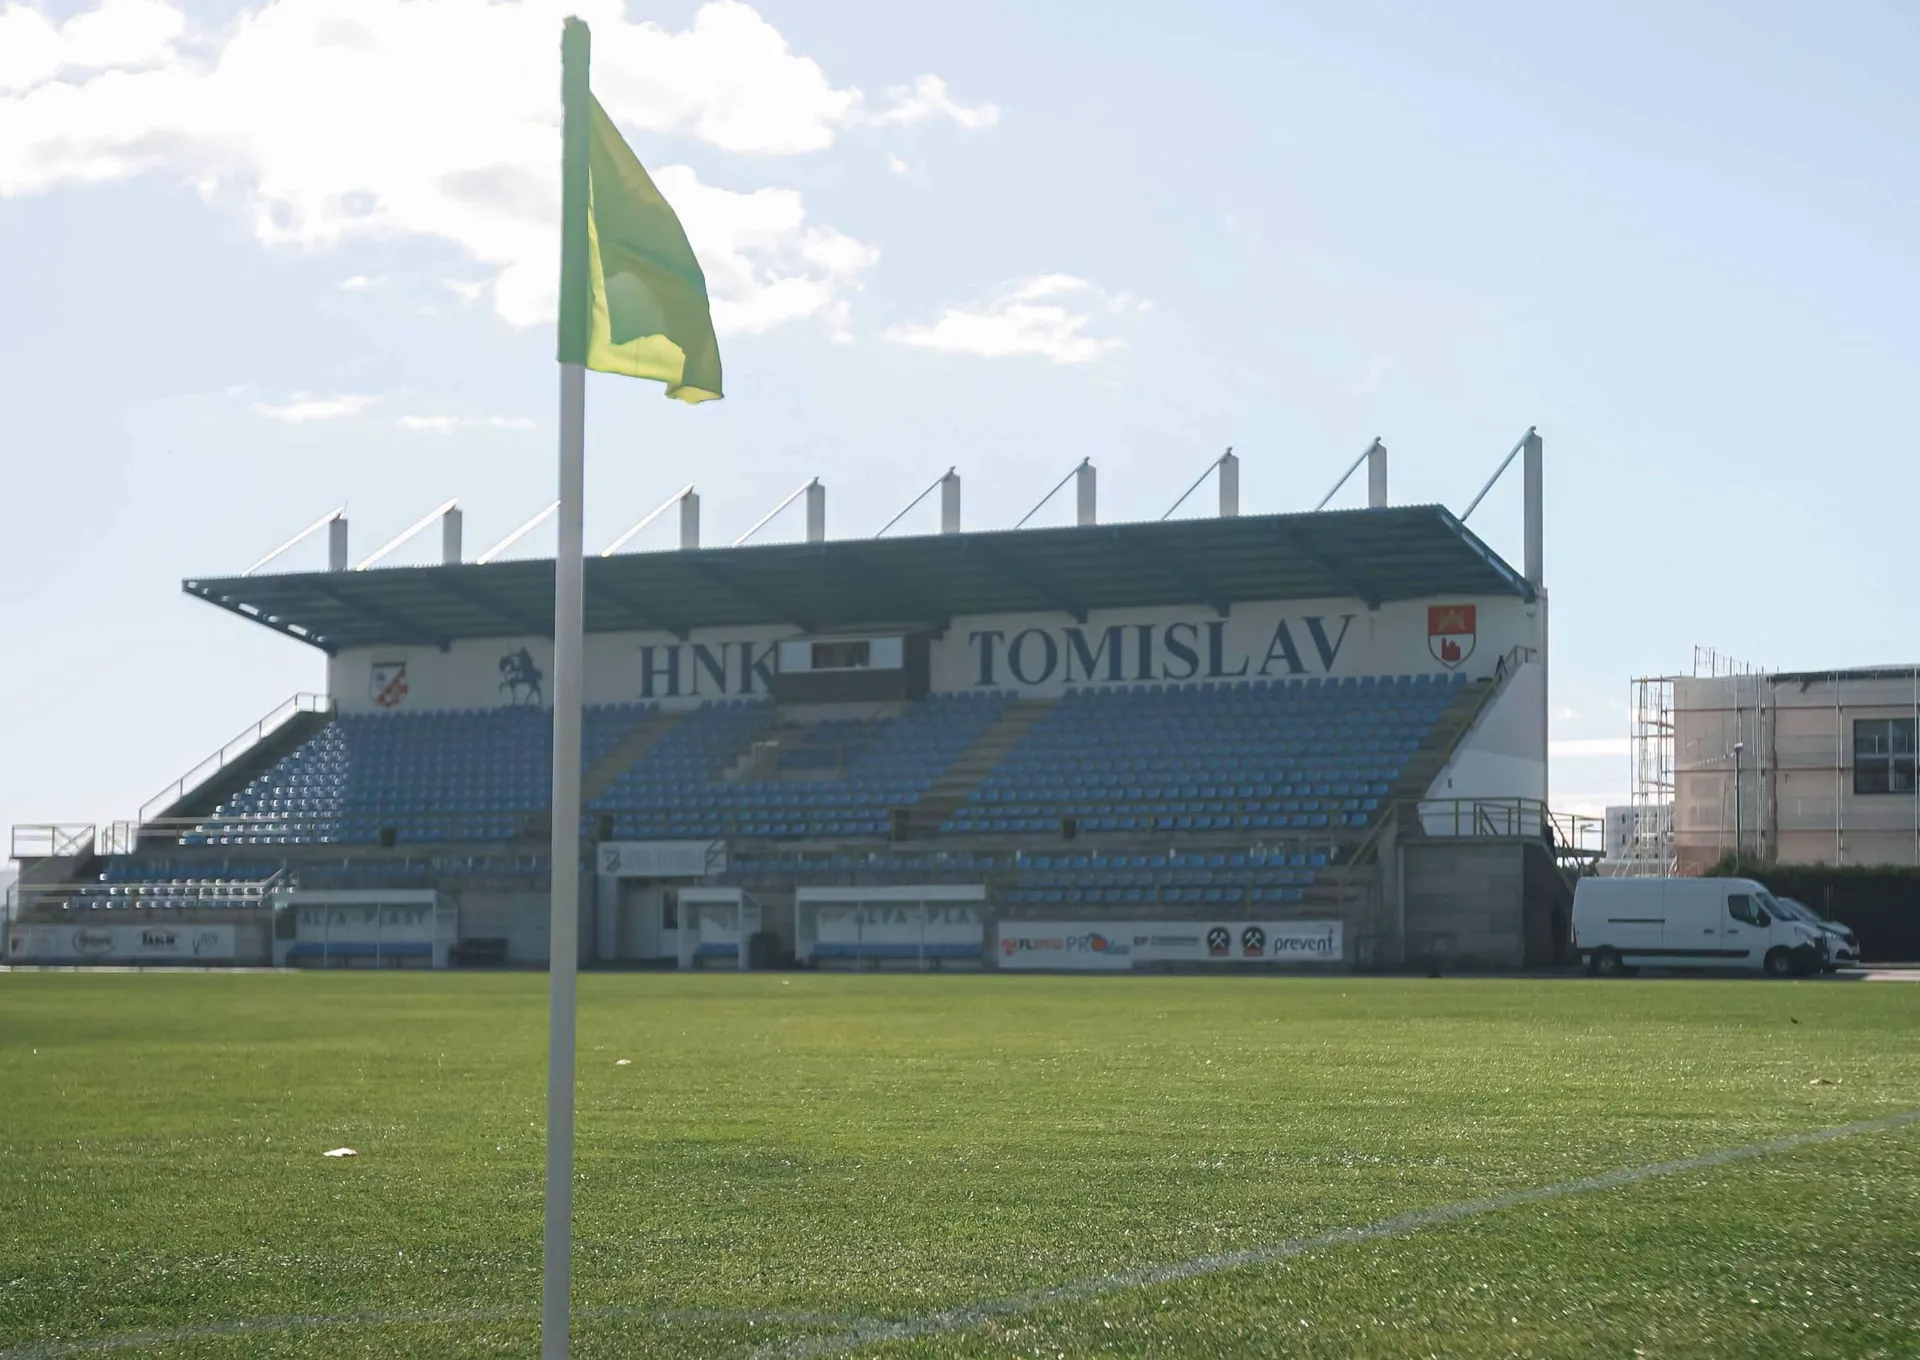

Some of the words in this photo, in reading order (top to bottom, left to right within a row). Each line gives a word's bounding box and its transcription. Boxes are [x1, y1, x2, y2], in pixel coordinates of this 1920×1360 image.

[638, 641, 777, 700] HNK
[968, 613, 1358, 686] TOMISLAV
[1274, 925, 1334, 956] prevent
